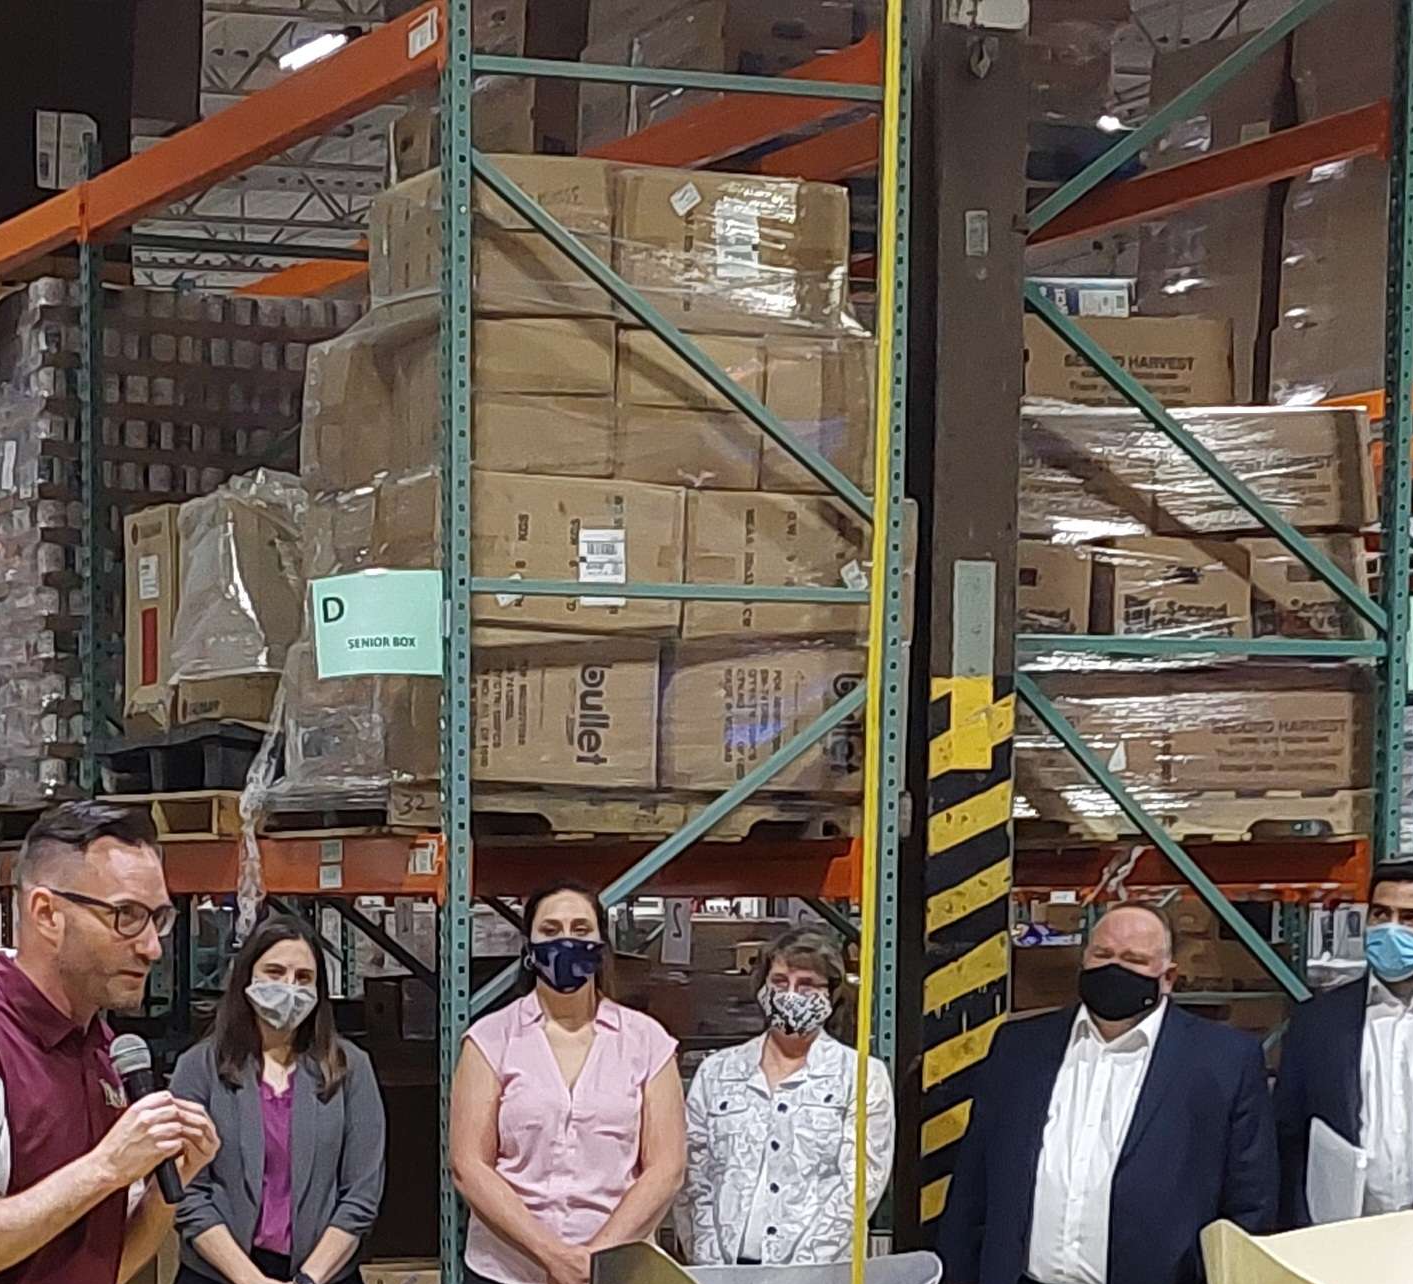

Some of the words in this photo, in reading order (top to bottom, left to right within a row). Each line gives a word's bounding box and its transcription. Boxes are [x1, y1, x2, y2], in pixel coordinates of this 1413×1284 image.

[322, 596, 345, 623] D
[347, 637, 391, 650] SENIOR
[392, 636, 417, 648] BOX
[576, 663, 613, 766] bullet
[397, 794, 434, 816] 32
